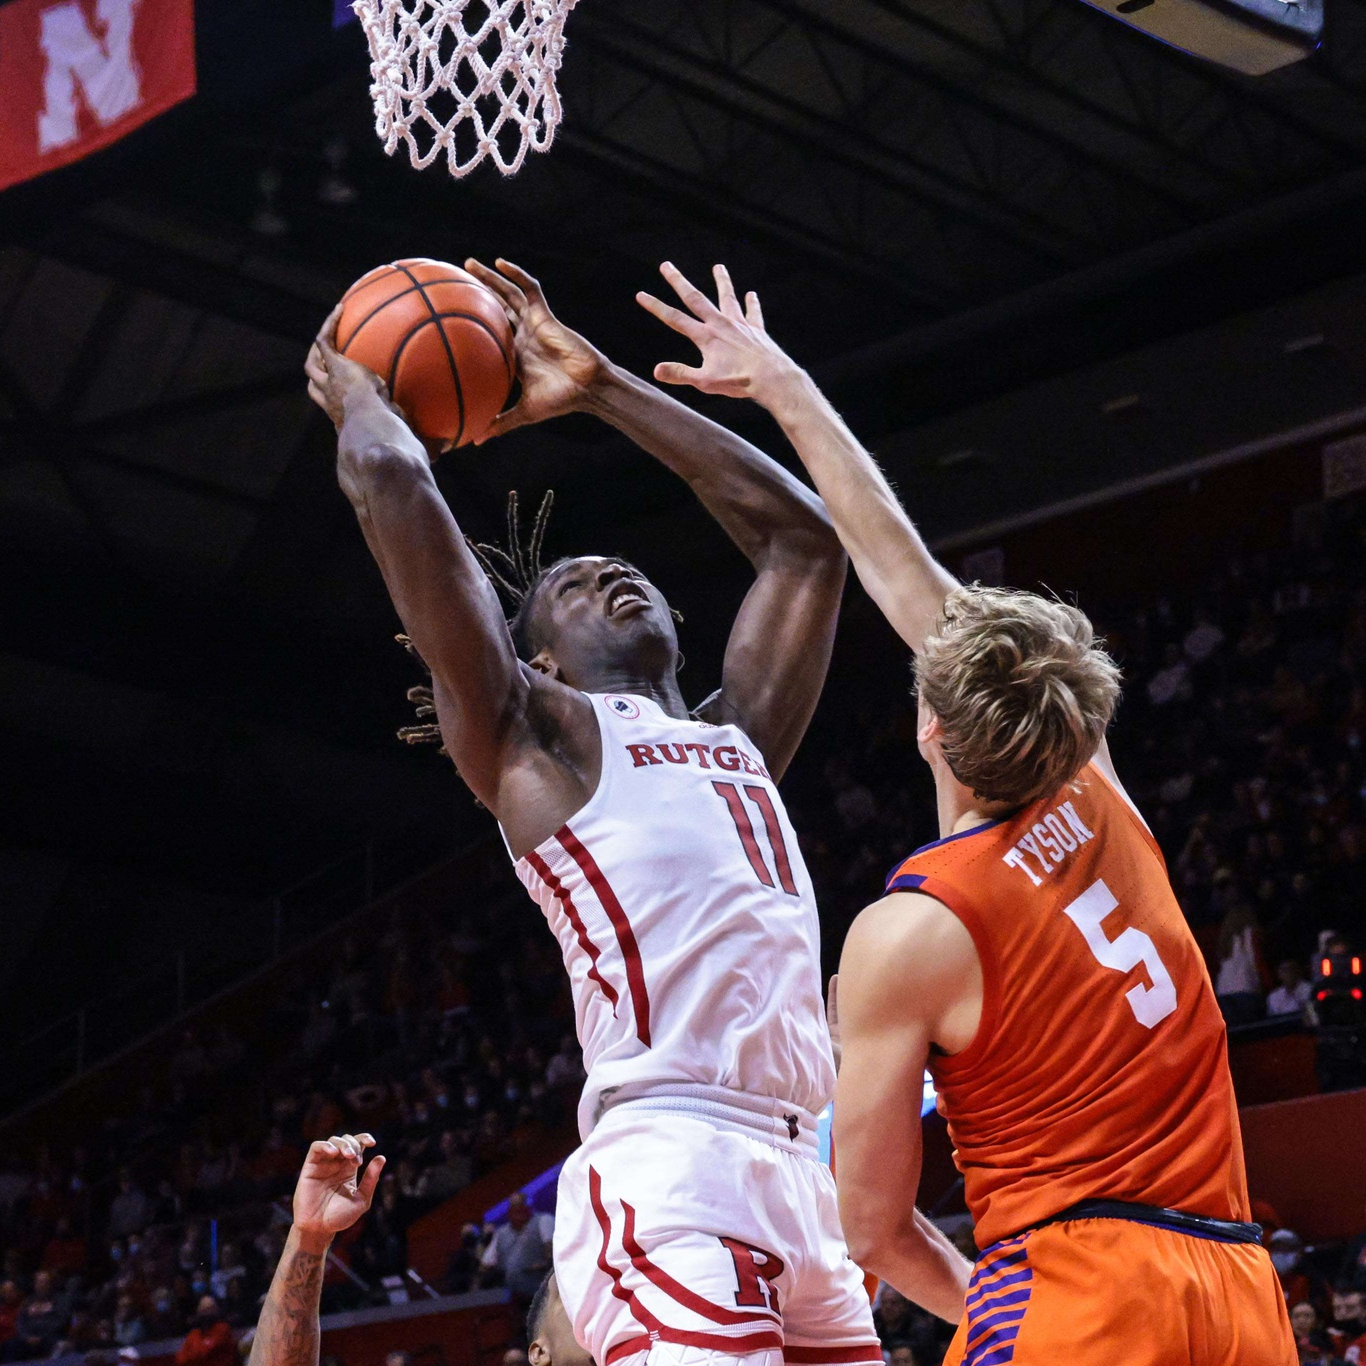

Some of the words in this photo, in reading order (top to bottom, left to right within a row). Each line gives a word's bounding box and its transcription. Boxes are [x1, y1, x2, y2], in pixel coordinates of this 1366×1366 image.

[711, 781, 800, 897] 11
[1002, 801, 1095, 887] TYSON
[1063, 878, 1178, 1029] 5
[718, 1236, 785, 1315] R
